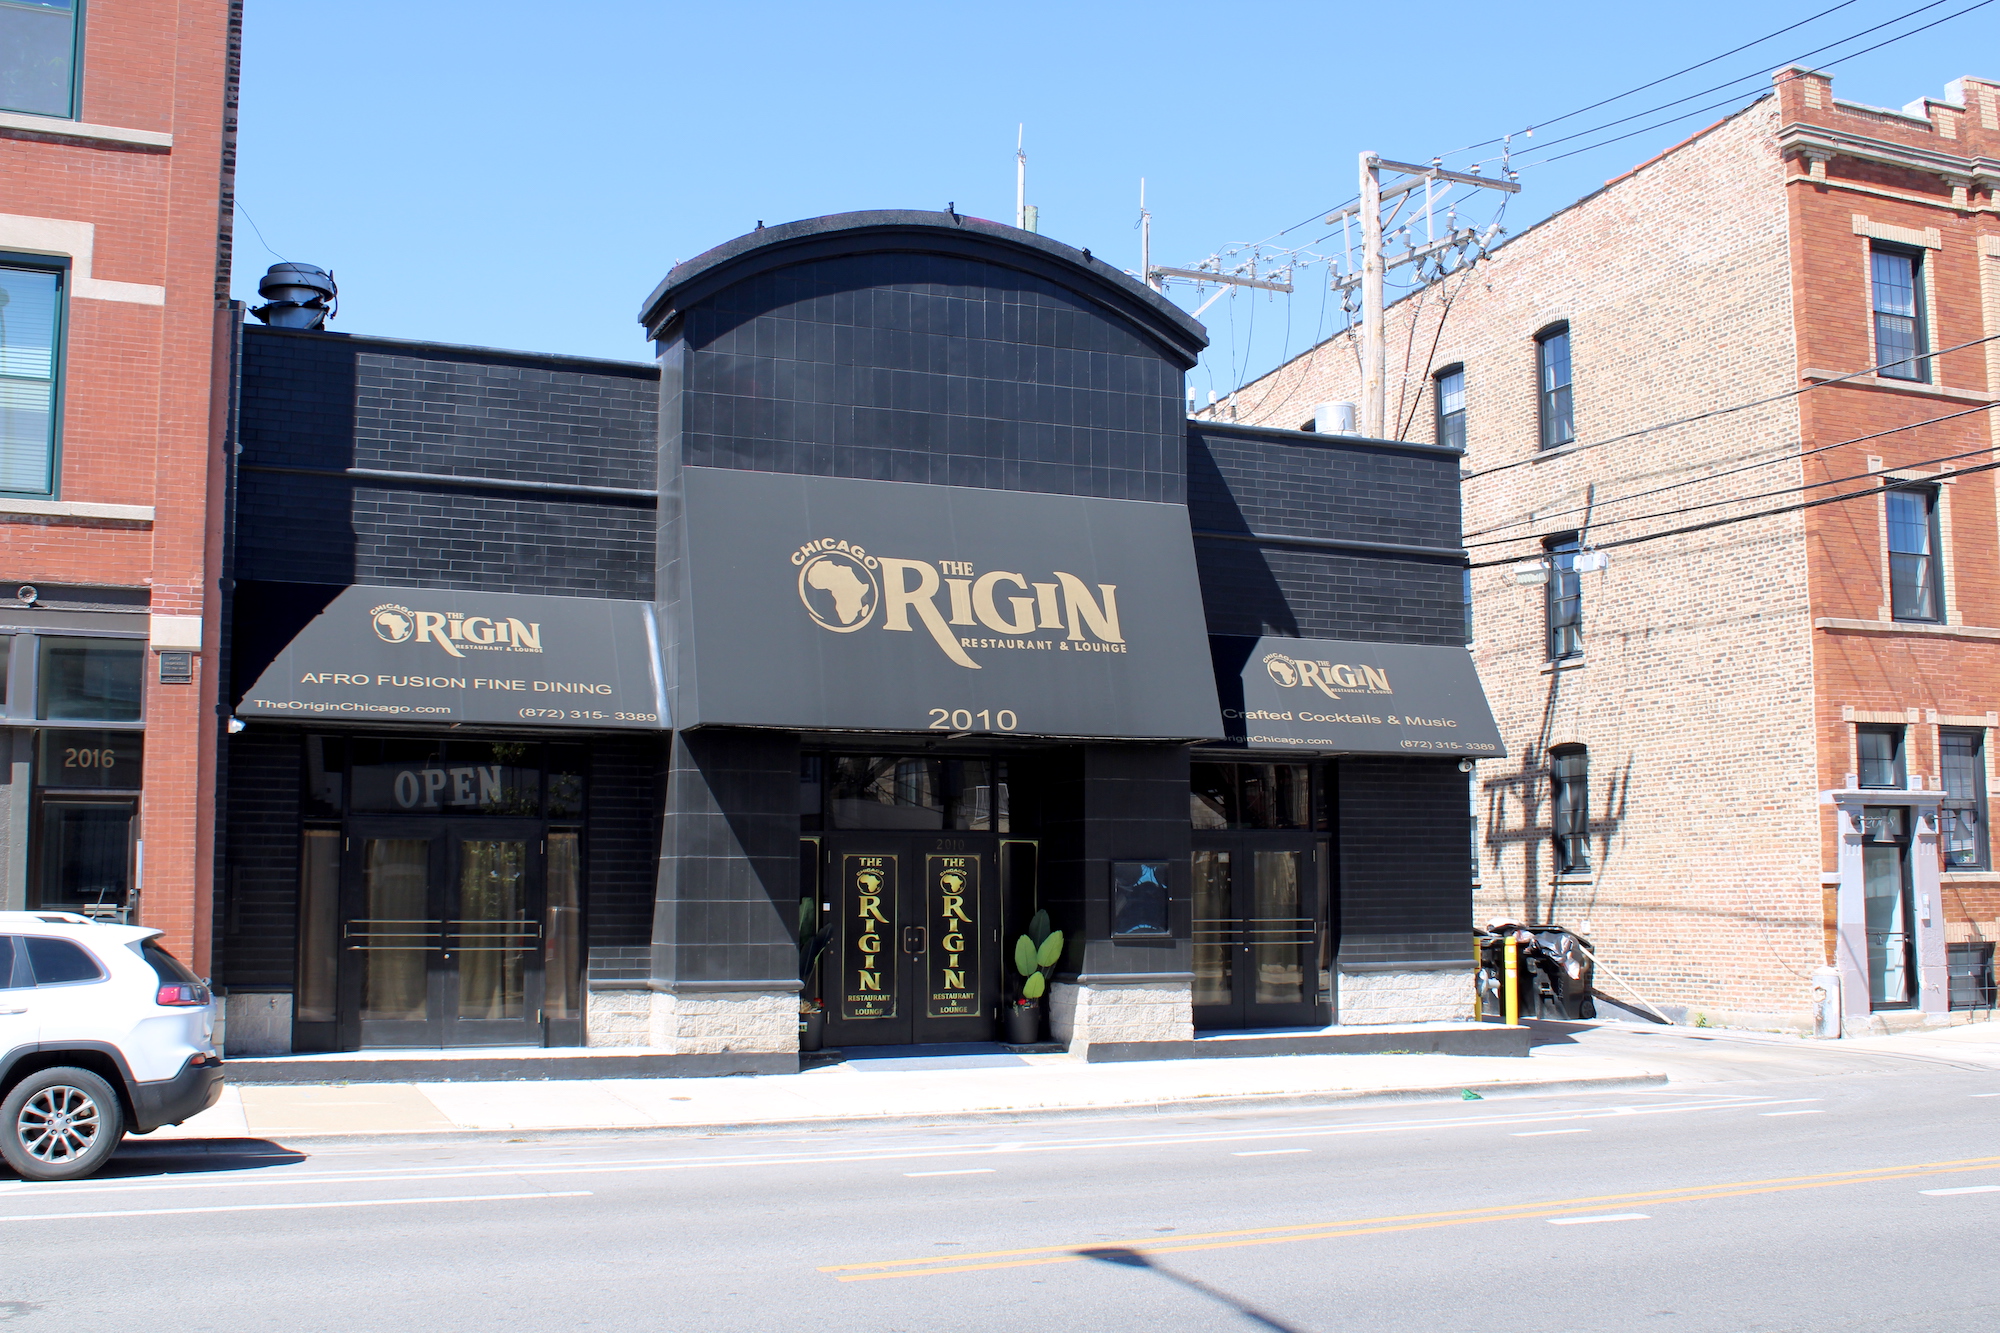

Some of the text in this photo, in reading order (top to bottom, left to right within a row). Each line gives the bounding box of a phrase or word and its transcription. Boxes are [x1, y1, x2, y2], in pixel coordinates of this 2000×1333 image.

[790, 537, 879, 570] CHICAGO
[939, 560, 974, 576] THE
[369, 603, 415, 617] CHICAGO
[446, 612, 465, 620] THE
[961, 637, 1127, 653] RESTAURANT & LOUNGE
[1262, 652, 1295, 665] CHICAGO
[301, 672, 613, 695] AFRO FUSION FINE DINING
[254, 699, 451, 715] TheOriginChicago.com
[519, 707, 658, 722] (872) 315- 3389
[928, 708, 1018, 731] 2010
[1222, 709, 1457, 728] Crafted Cocktails & Music
[1400, 740, 1433, 750] (872)
[1466, 742, 1495, 751] 3389
[64, 747, 115, 769] 2016
[394, 765, 502, 808] OPEN
[1865, 815, 1896, 829] 208
[936, 838, 965, 850] 2010
[859, 857, 883, 867] THE
[942, 858, 965, 867] THE
[856, 868, 885, 876] CHICAGO
[939, 868, 968, 876] CHICAGO
[847, 994, 891, 1002] RESTAURANT
[933, 992, 975, 1000] RESTAURANT
[940, 1006, 968, 1014] LOUNGE
